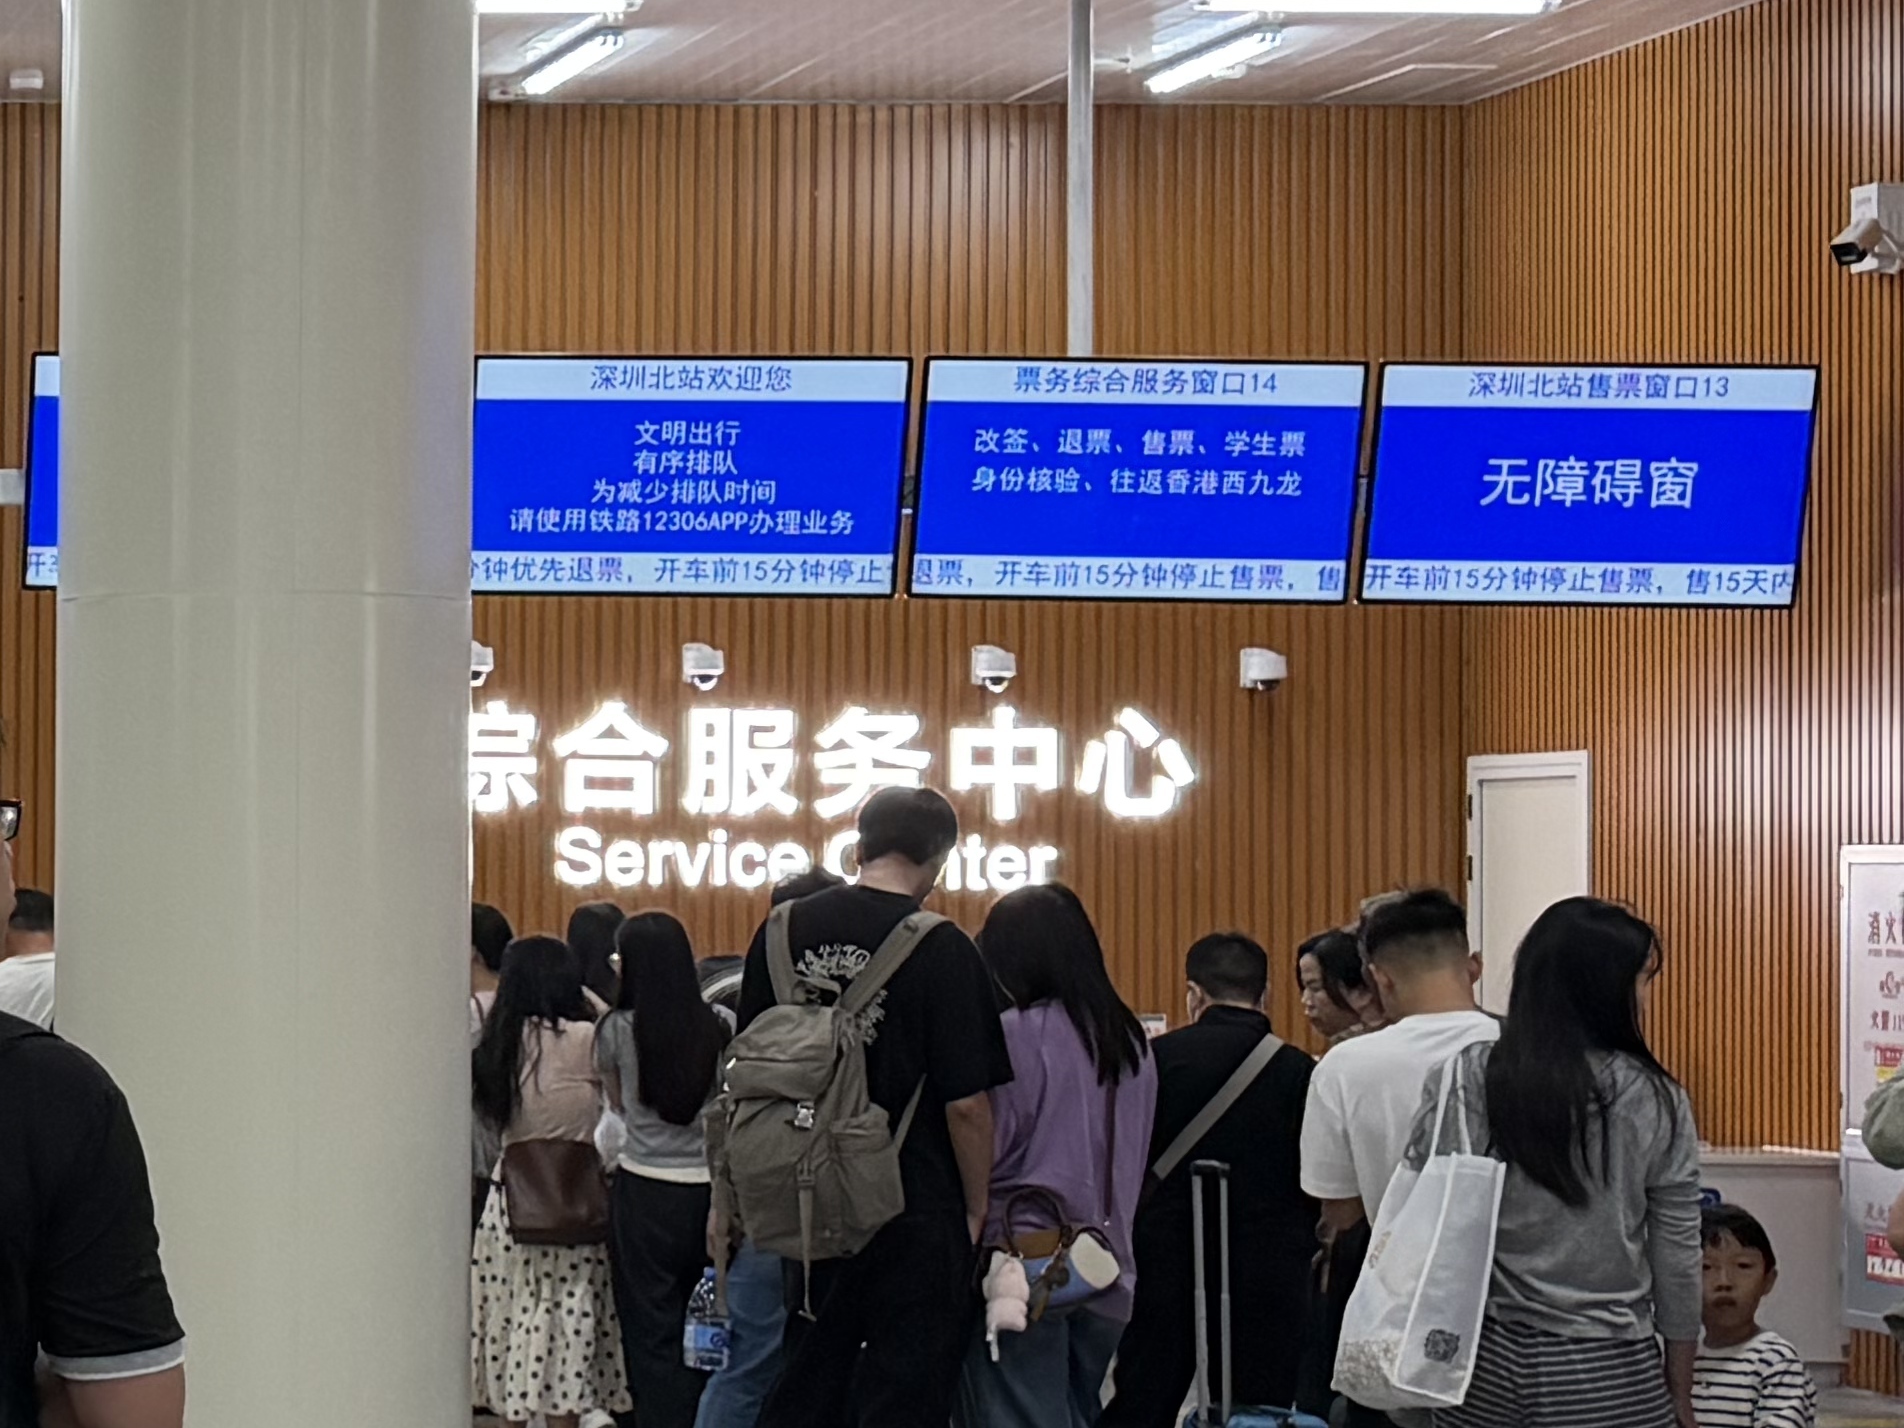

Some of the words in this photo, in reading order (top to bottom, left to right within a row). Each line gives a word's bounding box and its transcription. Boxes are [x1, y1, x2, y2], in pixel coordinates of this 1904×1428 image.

[590, 365, 792, 393] 深圳北站欢迎您
[1013, 365, 1278, 395] 票务综合服务窗口14
[1468, 371, 1729, 400] 深圳北站售票窗口13
[633, 420, 742, 447] 文明出行
[973, 428, 1306, 458] 改签、退票、售票、学生票
[633, 451, 739, 476] 有序排队
[591, 478, 777, 505] 为减少排队时间
[971, 467, 1303, 497] 身份核验、往返香港西九龙
[1479, 456, 1700, 509] 无障碍窗
[509, 508, 855, 537] 请使用铁路12306APP办理业务
[472, 556, 891, 586] 钟优先退票，开车前15分钟停止
[554, 825, 810, 890] Service
[823, 828, 1058, 890] Cter
